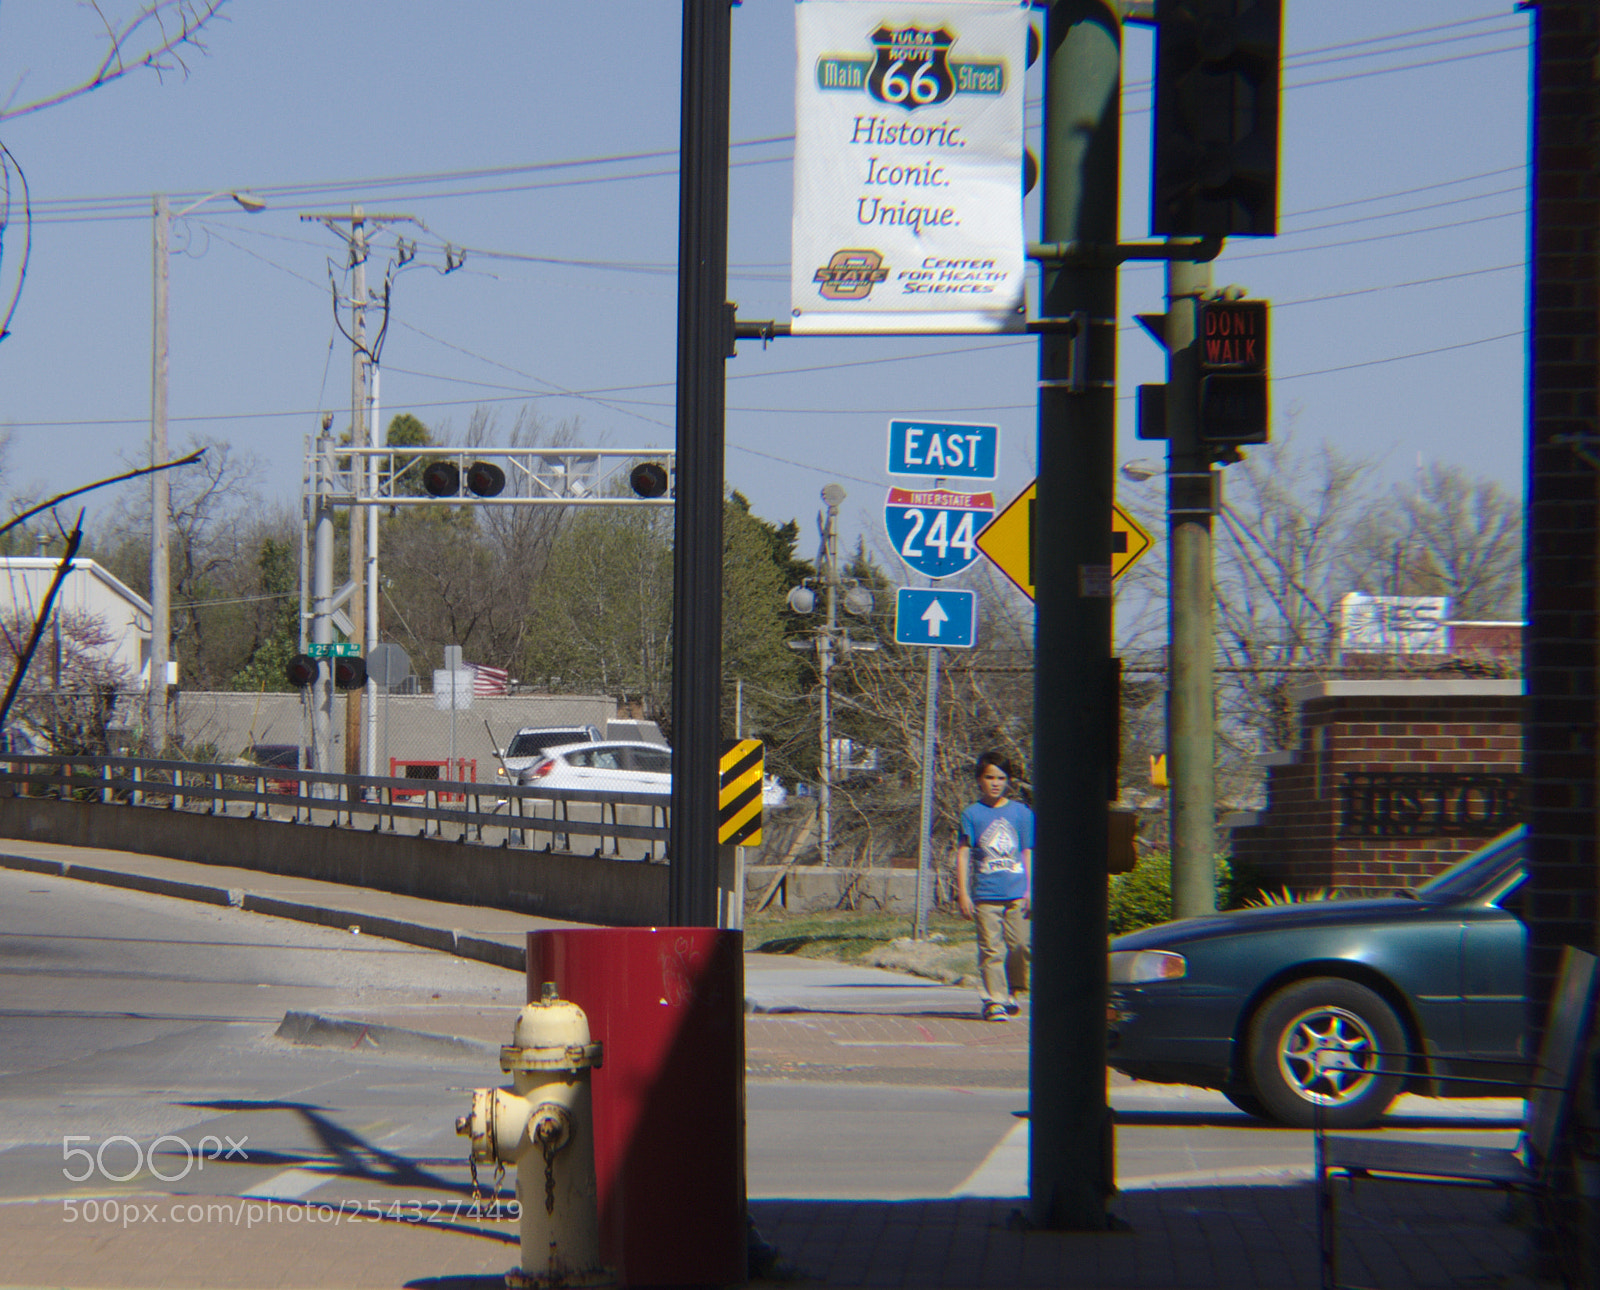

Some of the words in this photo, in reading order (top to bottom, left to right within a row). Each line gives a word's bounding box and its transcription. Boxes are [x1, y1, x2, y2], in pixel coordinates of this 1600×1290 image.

[889, 30, 935, 45] TULSA
[888, 47, 935, 61] ROUTE
[824, 62, 862, 87] Main
[881, 59, 941, 104] 66
[958, 64, 1002, 92] Street
[850, 115, 967, 148] Historic.
[864, 156, 951, 187] Iconic.
[857, 197, 961, 237] Unique.
[814, 267, 888, 282] STATE
[1205, 311, 1256, 336] DONT
[1205, 339, 1256, 364] WALK
[903, 428, 982, 468] EAST
[910, 492, 972, 507] INTERSTATE
[901, 508, 975, 560] 244
